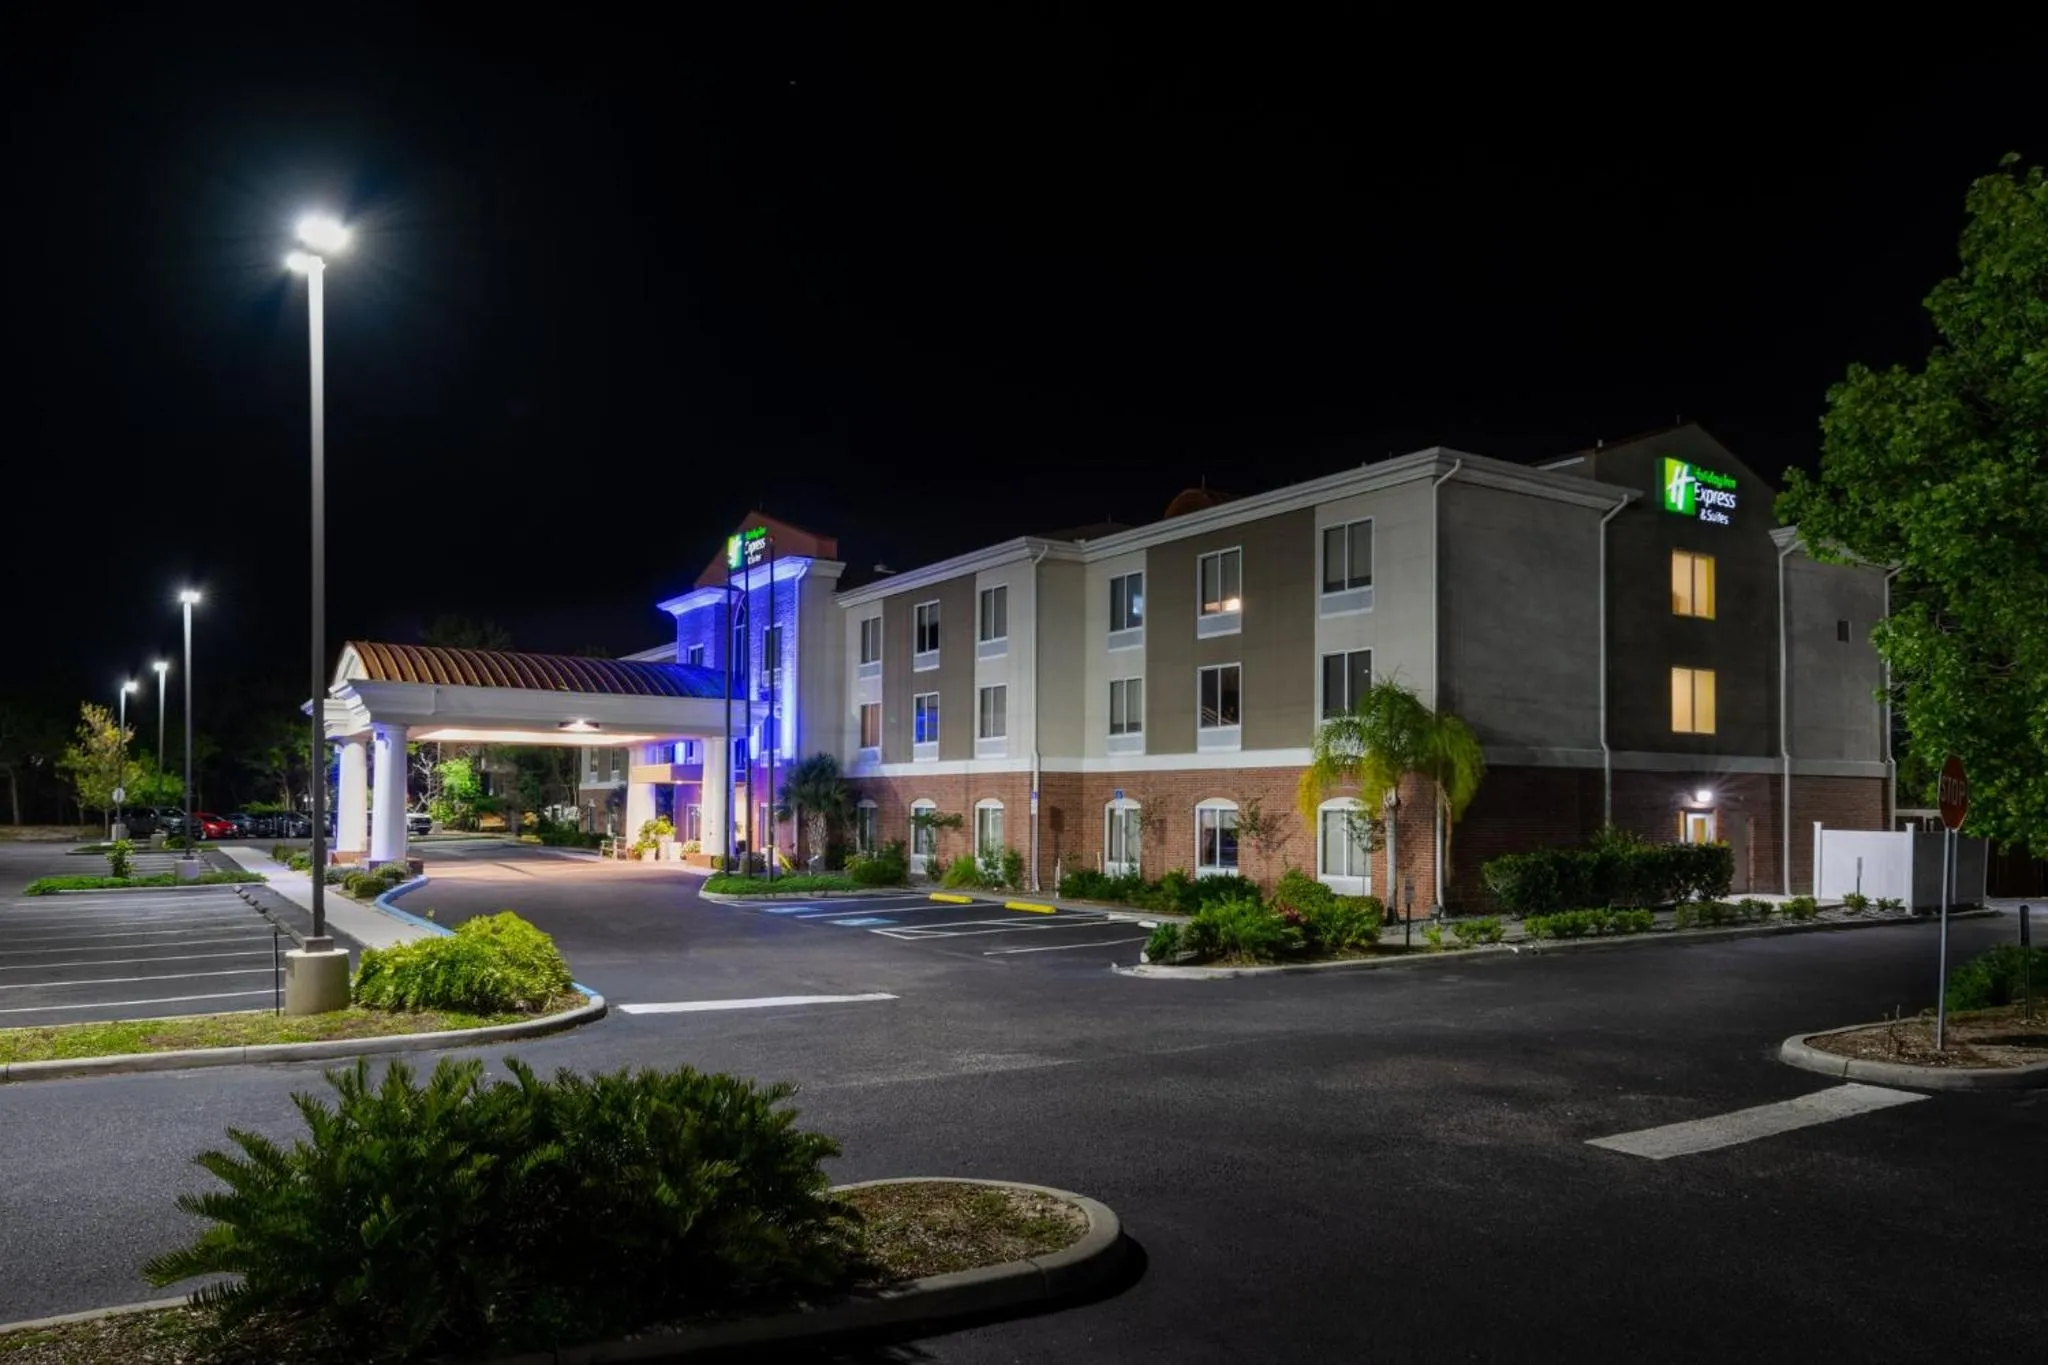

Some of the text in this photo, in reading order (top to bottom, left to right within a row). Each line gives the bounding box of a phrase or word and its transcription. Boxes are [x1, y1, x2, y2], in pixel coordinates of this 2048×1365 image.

[1694, 481, 1736, 509] Express
[1706, 509, 1729, 525] Suites
[1940, 775, 1967, 806] STOP
